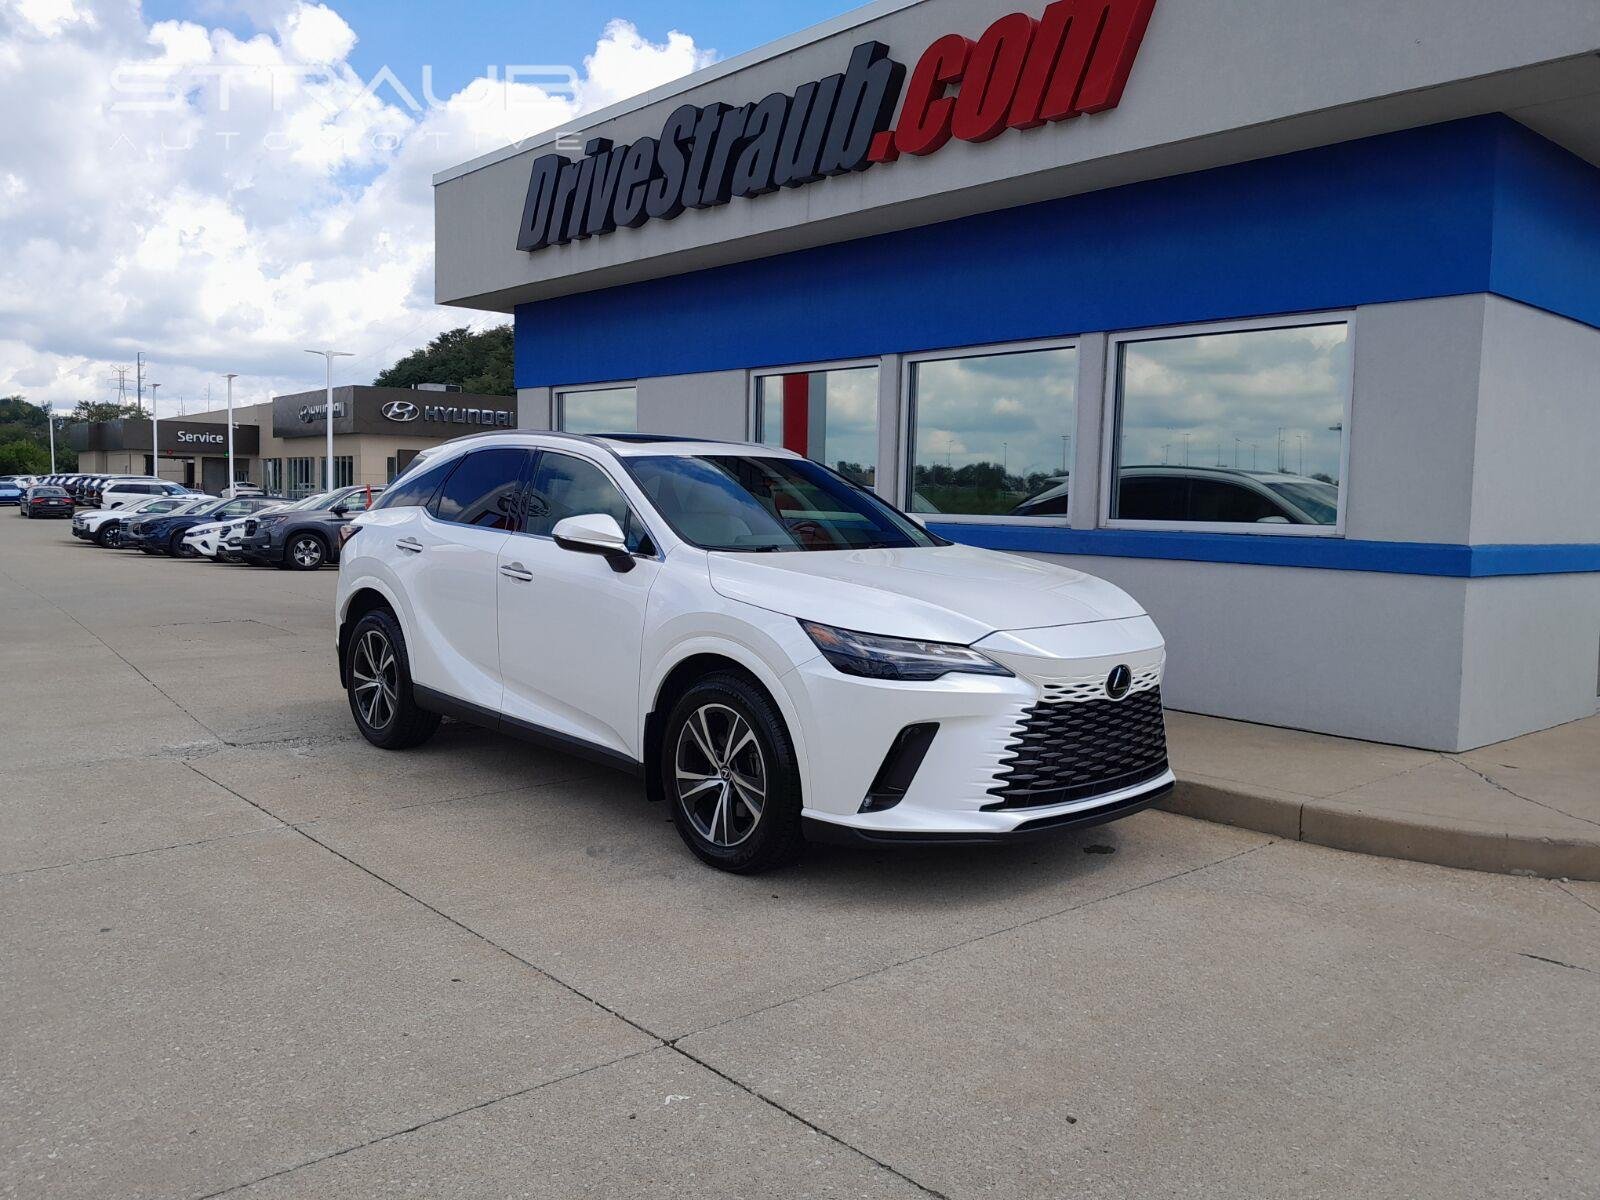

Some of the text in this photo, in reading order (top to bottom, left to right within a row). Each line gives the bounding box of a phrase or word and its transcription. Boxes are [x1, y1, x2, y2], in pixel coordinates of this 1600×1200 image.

[516, 0, 1157, 252] DriveStraub.com
[424, 405, 514, 427] HYUNDAI
[177, 430, 224, 444] Service
